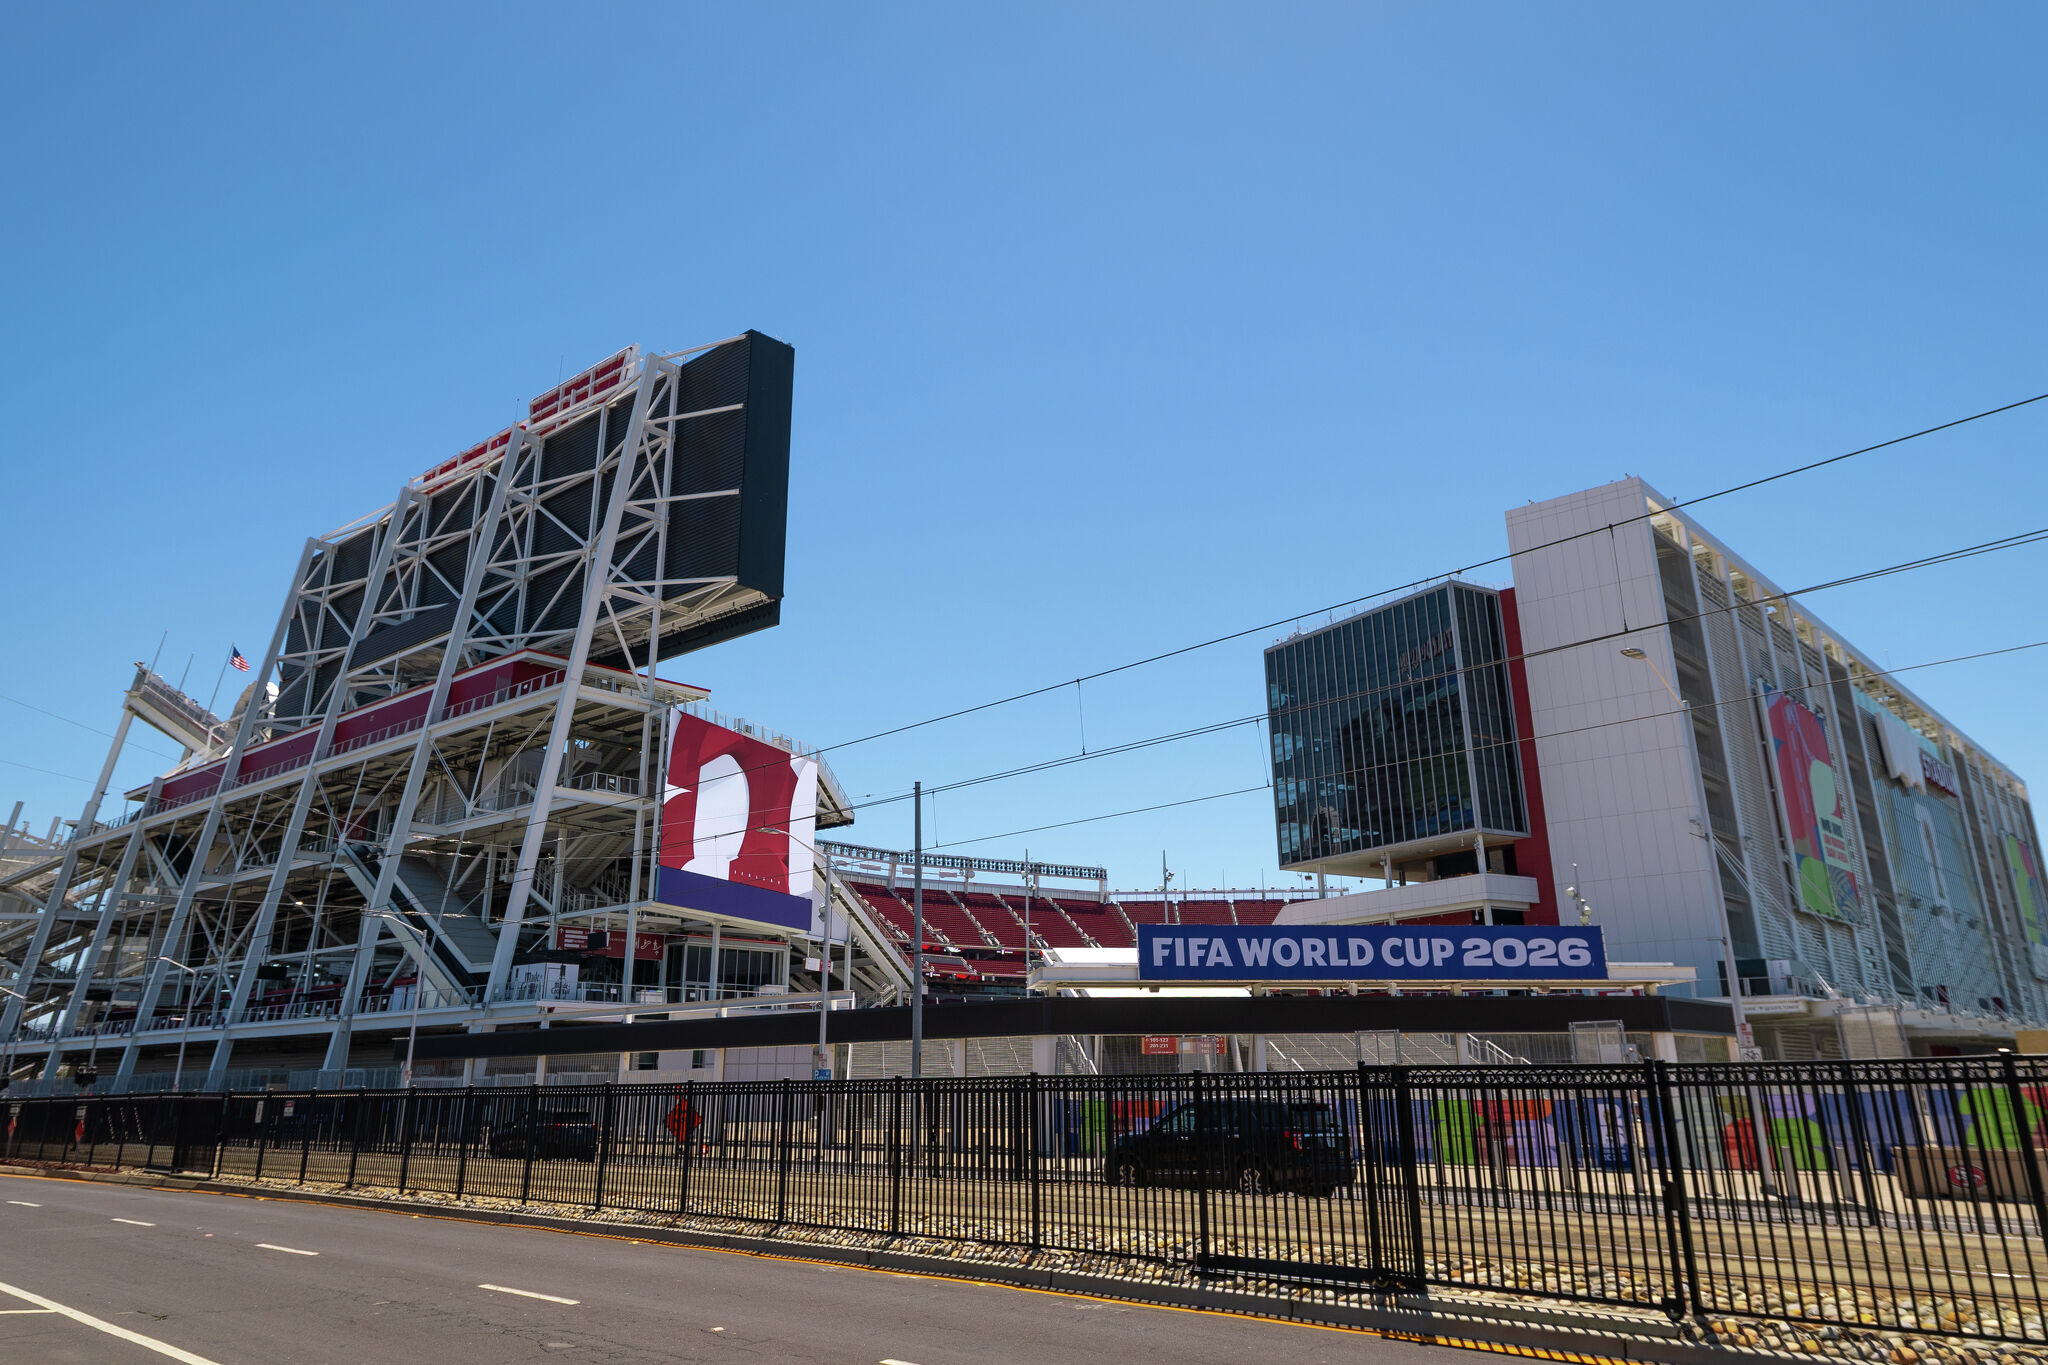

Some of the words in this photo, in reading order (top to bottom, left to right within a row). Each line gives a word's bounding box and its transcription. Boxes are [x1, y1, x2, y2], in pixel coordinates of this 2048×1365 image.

[1152, 937, 1233, 967] FIFA
[1238, 937, 1374, 967] WORLD
[1382, 937, 1454, 967] CUP
[1463, 937, 1592, 967] 2026
